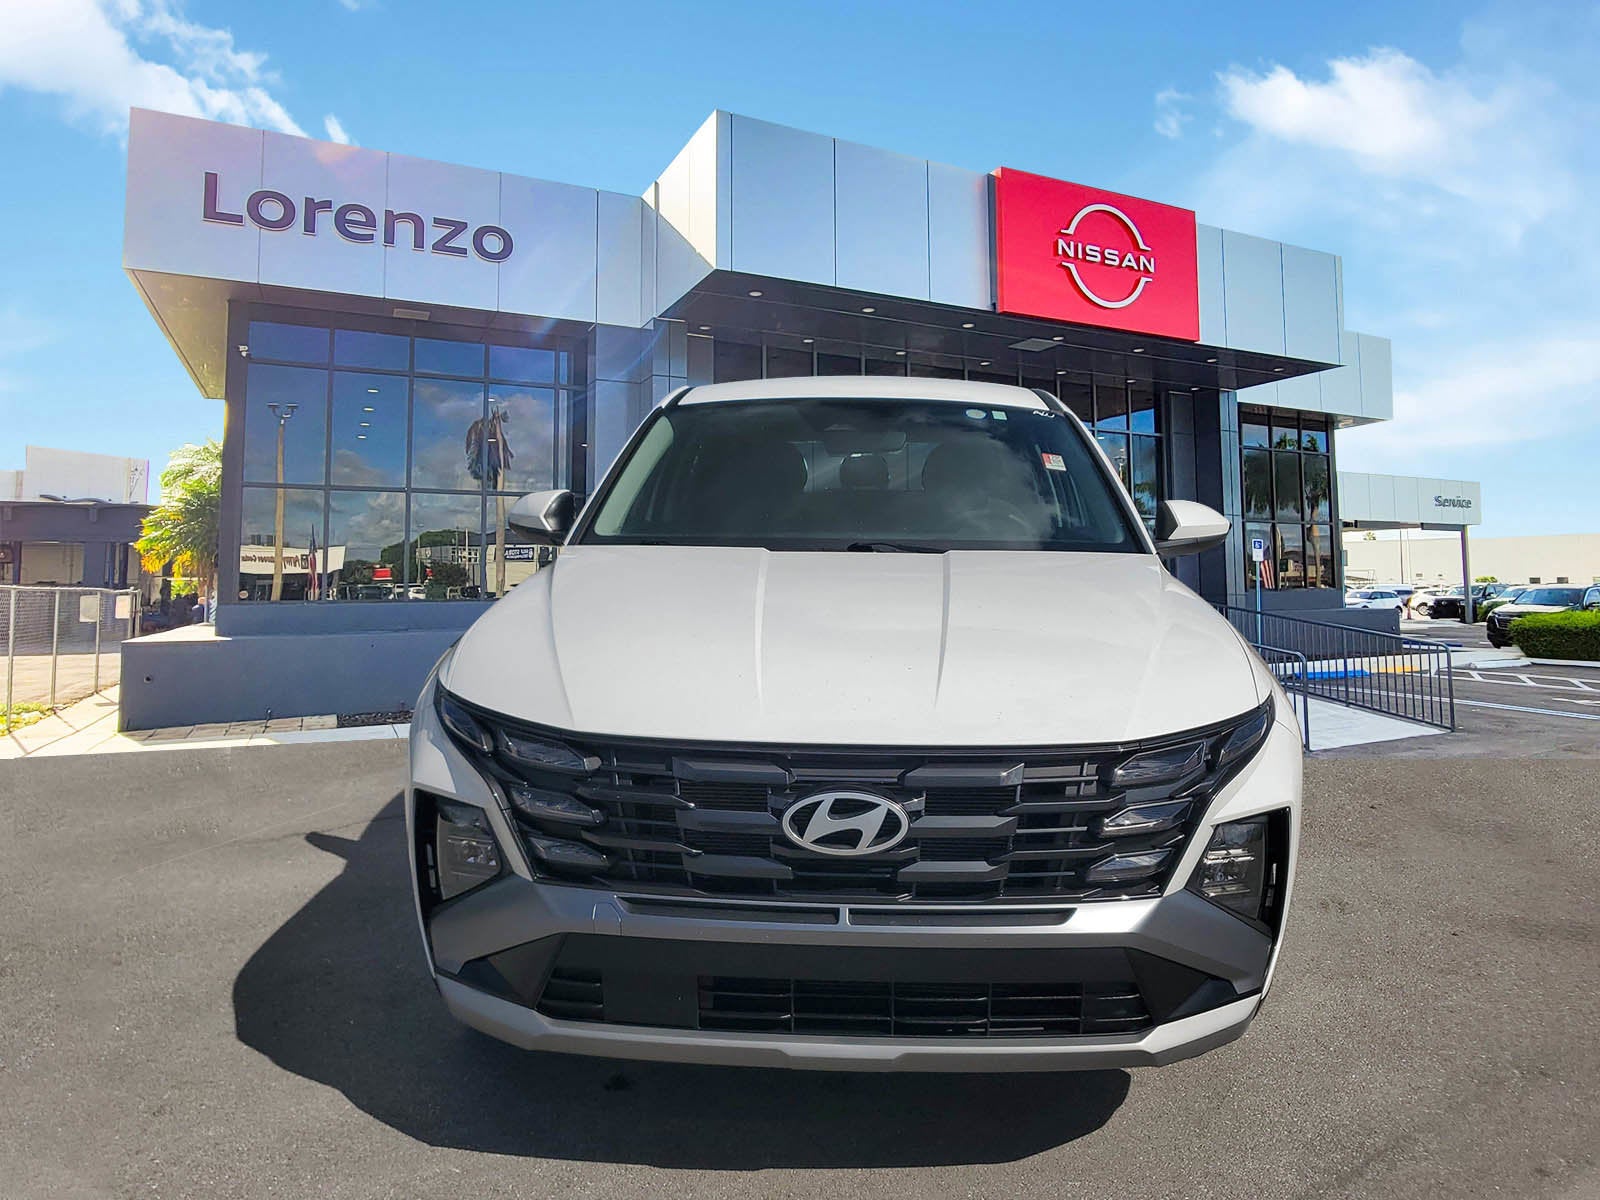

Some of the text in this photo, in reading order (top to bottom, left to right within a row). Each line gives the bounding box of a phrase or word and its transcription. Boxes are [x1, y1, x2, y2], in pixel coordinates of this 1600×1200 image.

[202, 171, 514, 262] Lorenzo
[1057, 238, 1155, 272] NISSAN
[1433, 495, 1472, 509] Service
